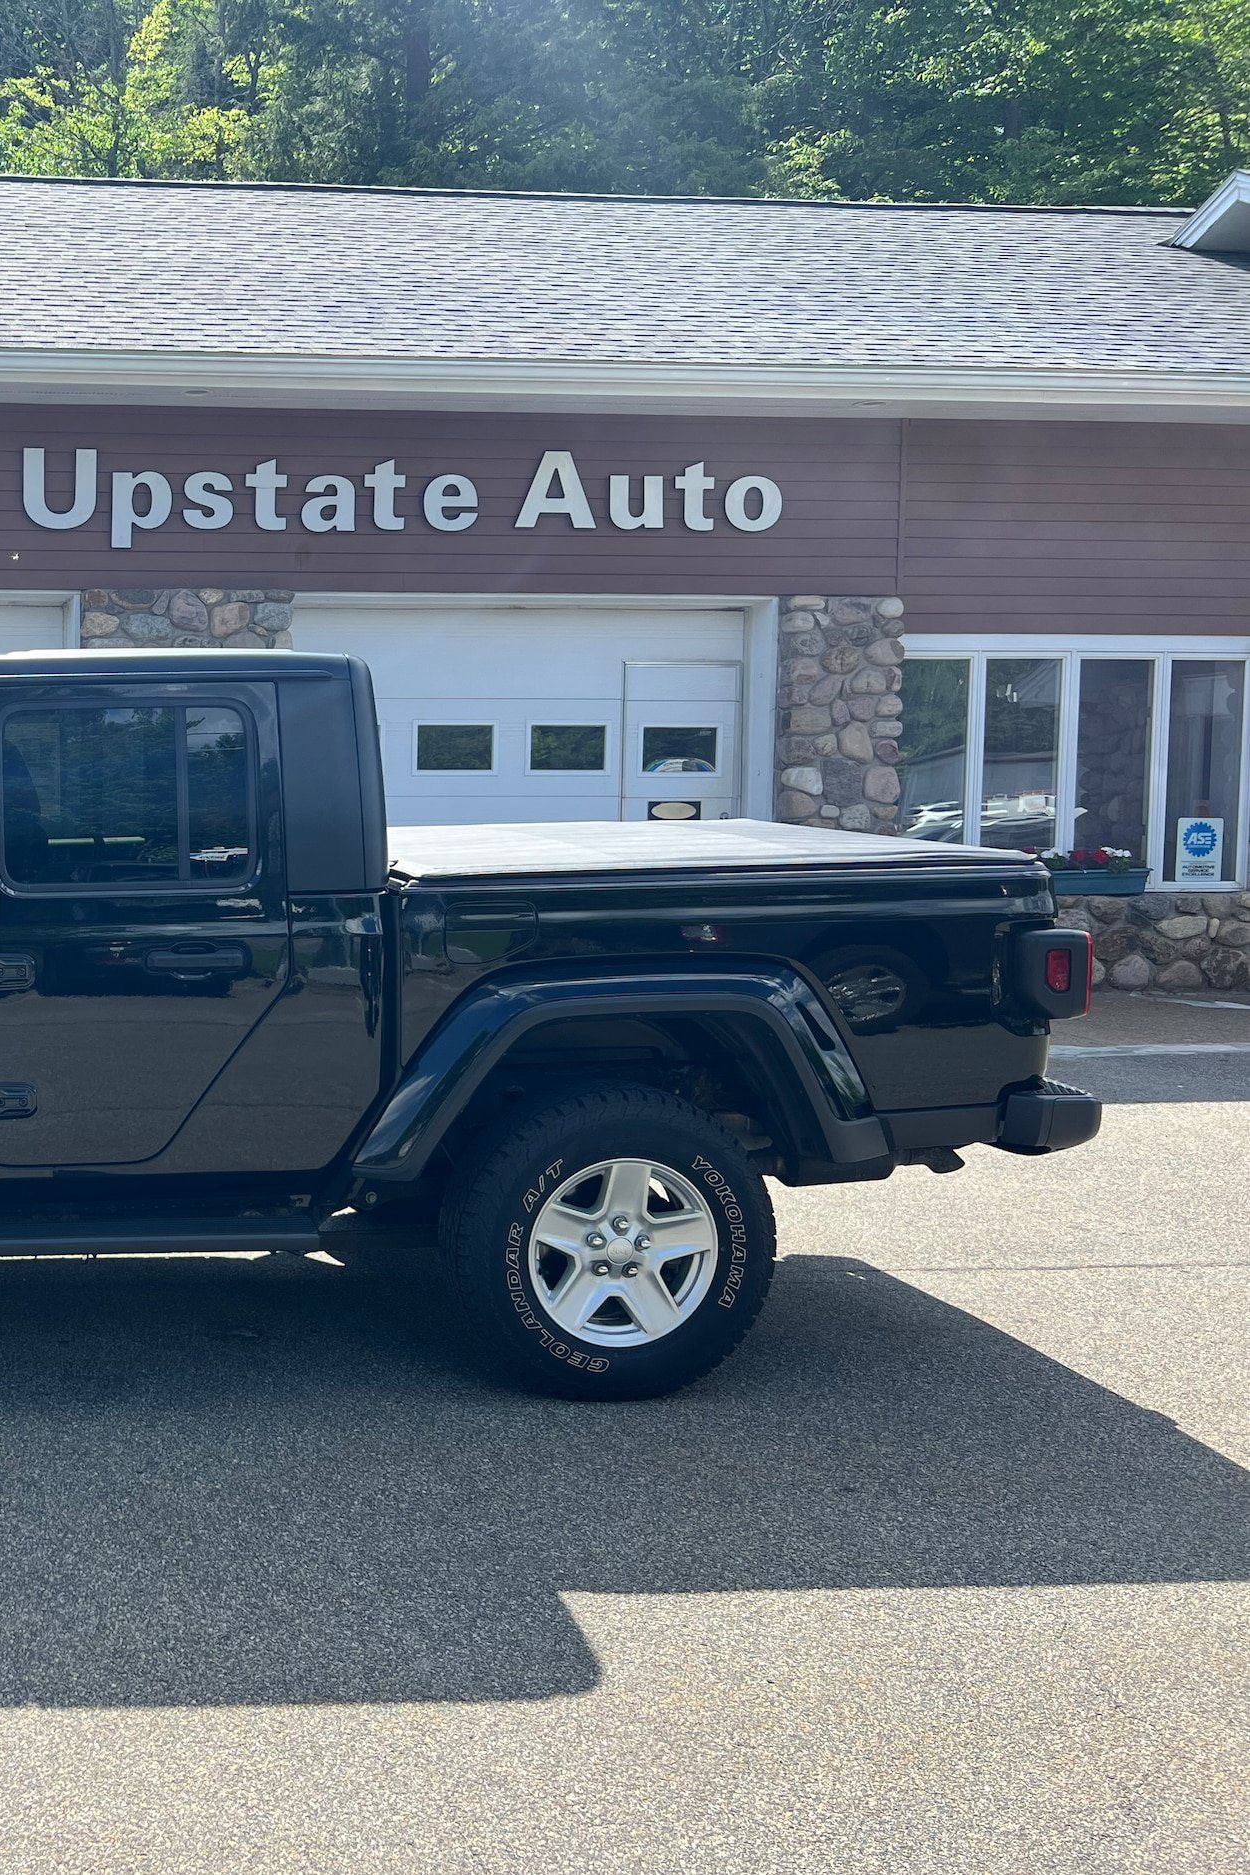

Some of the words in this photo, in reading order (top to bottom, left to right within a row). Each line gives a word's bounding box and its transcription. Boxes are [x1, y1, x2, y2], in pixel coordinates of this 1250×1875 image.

[22, 447, 479, 550] Upstate
[514, 450, 784, 532] Auto
[1187, 832, 1212, 845] ASE
[522, 1159, 563, 1213] A/T
[691, 1155, 747, 1309] YOKOHAMA
[506, 1222, 610, 1373] GEOLANDAR
